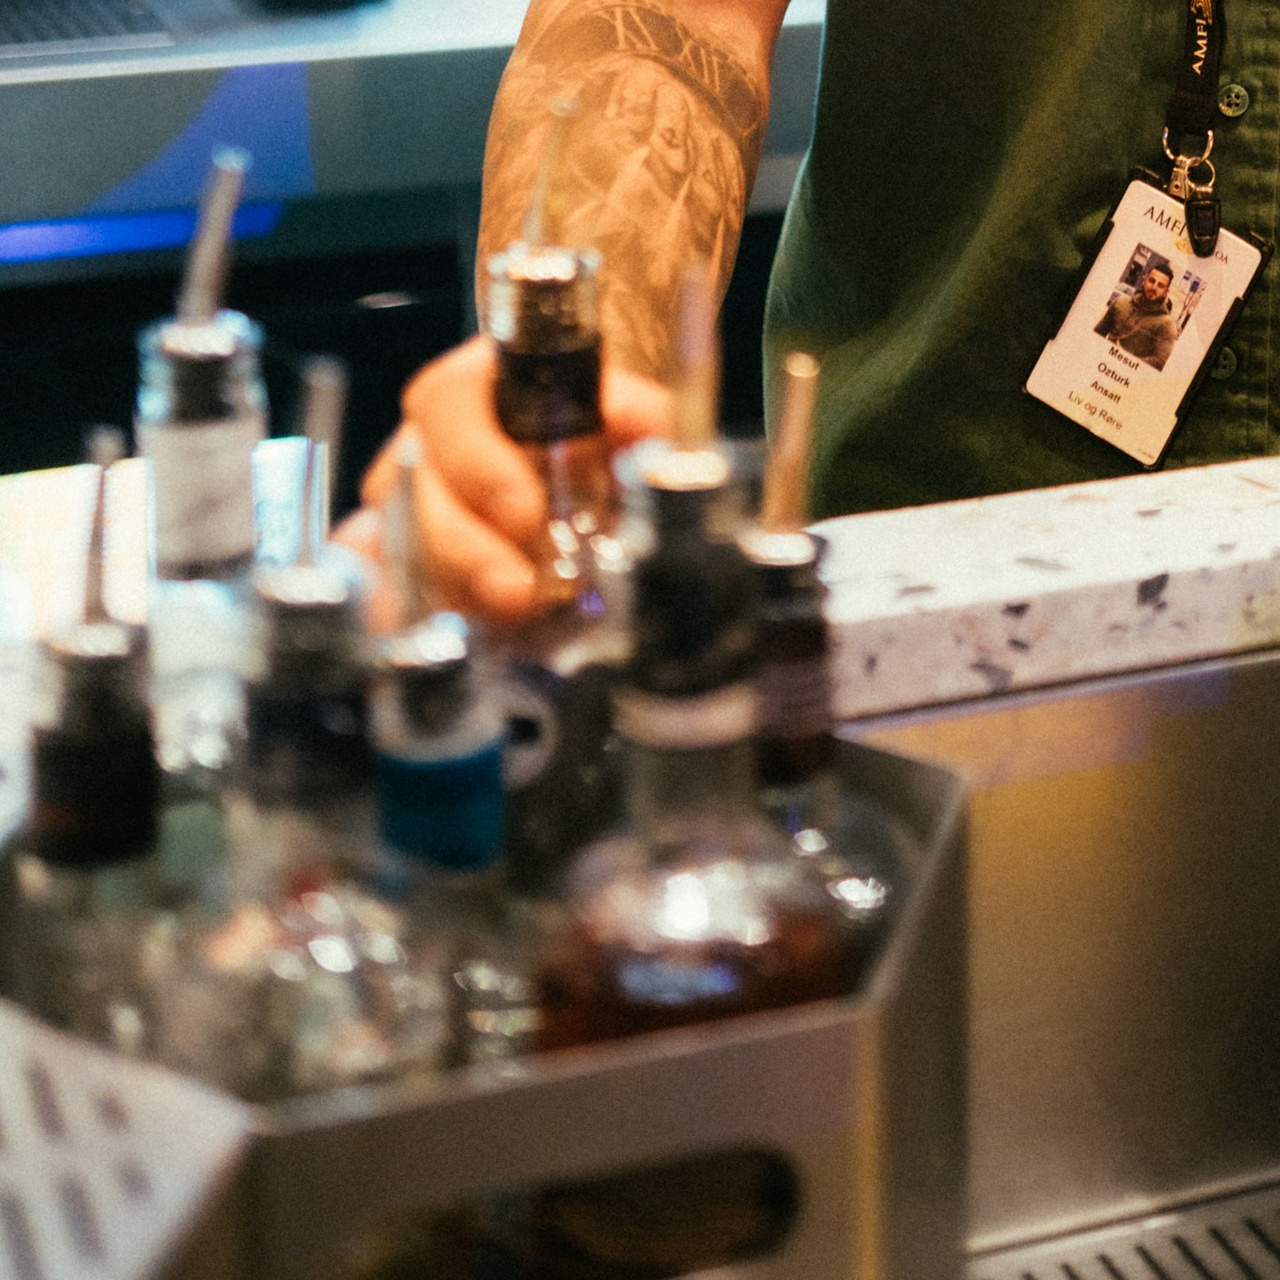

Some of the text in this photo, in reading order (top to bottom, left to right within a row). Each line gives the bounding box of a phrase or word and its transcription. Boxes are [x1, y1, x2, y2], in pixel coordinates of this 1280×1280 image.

[1192, 18, 1208, 76] AMFI
[1144, 206, 1187, 237] AMFI
[1109, 346, 1140, 371] Mesut
[1068, 391, 1083, 405] Liv
[1084, 402, 1098, 416] og
[1090, 380, 1122, 404] Ansatt
